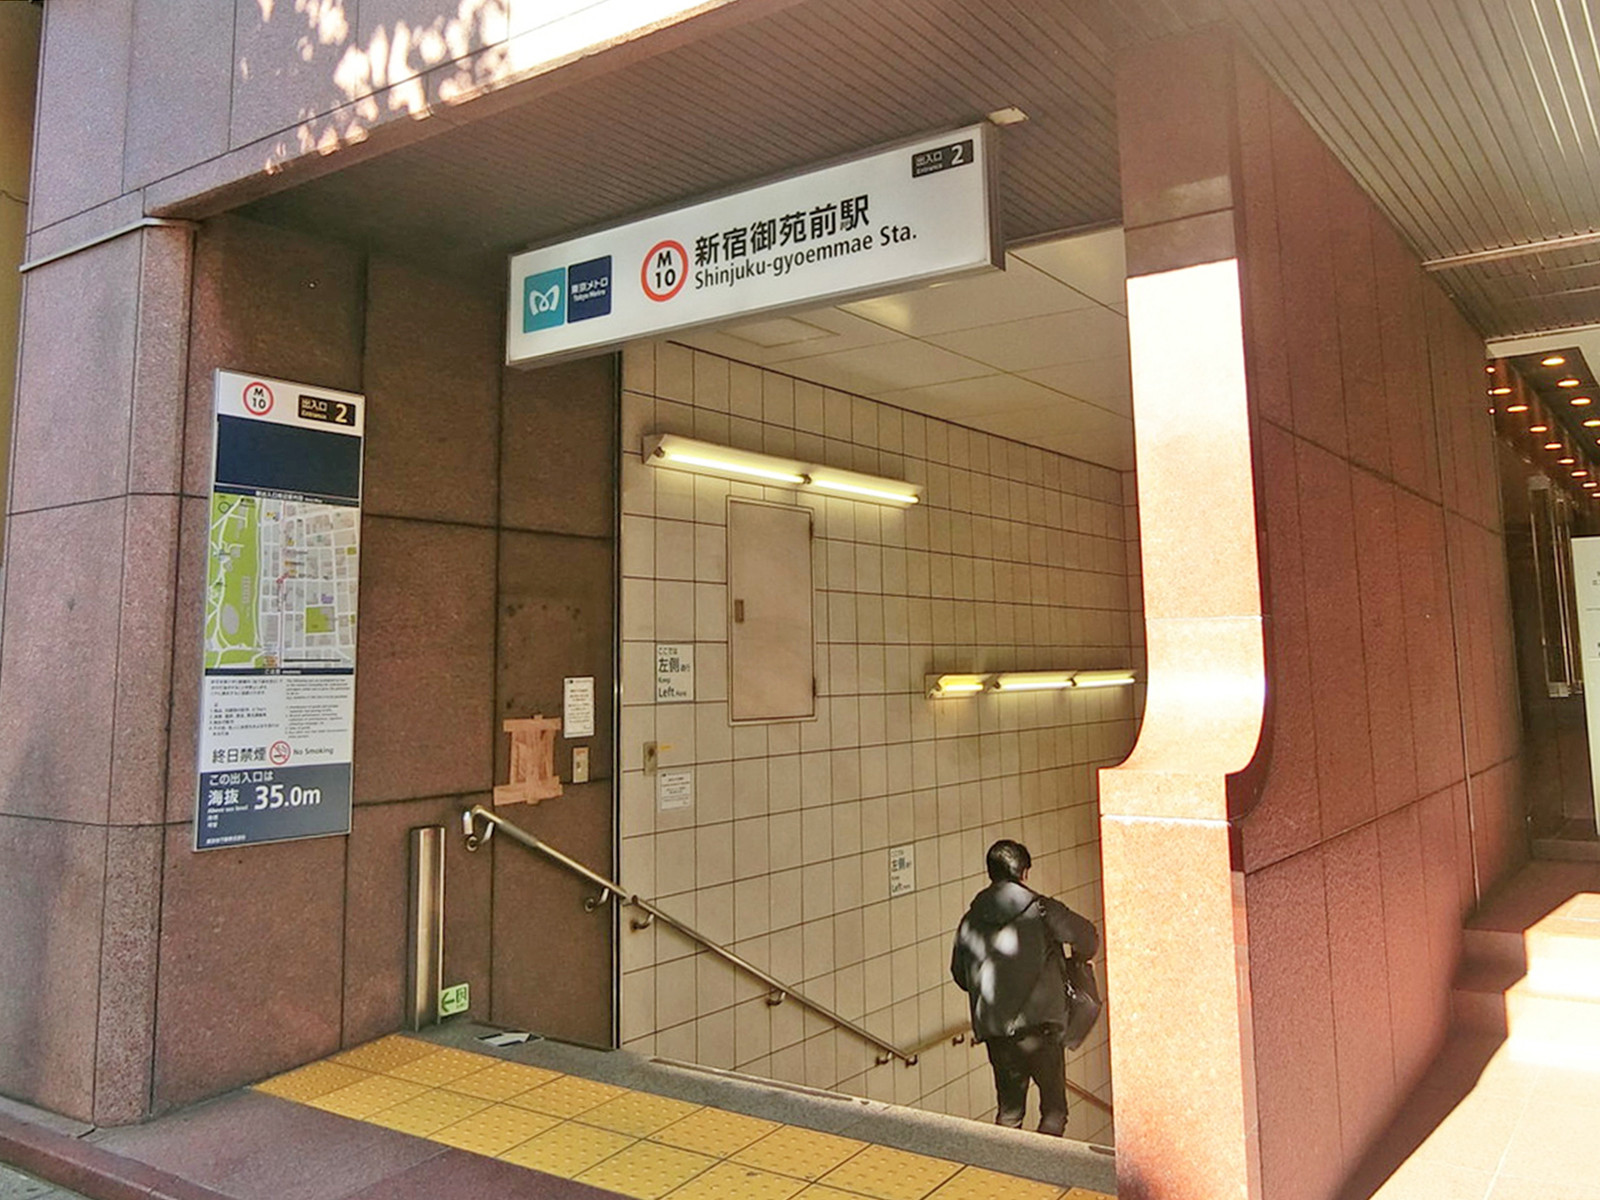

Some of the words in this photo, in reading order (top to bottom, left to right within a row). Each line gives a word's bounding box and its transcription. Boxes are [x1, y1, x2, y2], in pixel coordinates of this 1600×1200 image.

[951, 144, 965, 167] 2
[694, 194, 871, 268] 新宿御苑前駅
[657, 251, 673, 269] M
[694, 234, 873, 289] Shinjuku-gyoemmae
[880, 225, 918, 247] Sta.
[655, 268, 676, 289] 10
[253, 387, 265, 398] M
[252, 397, 267, 409] 10
[335, 403, 348, 424] 2
[658, 686, 675, 698] Left
[212, 748, 267, 764] 終日禁煙
[293, 748, 304, 756] No
[304, 747, 335, 757] Smoking
[209, 771, 274, 786] この出入口は
[207, 788, 240, 807] 海抜
[253, 784, 321, 811] 35.0m
